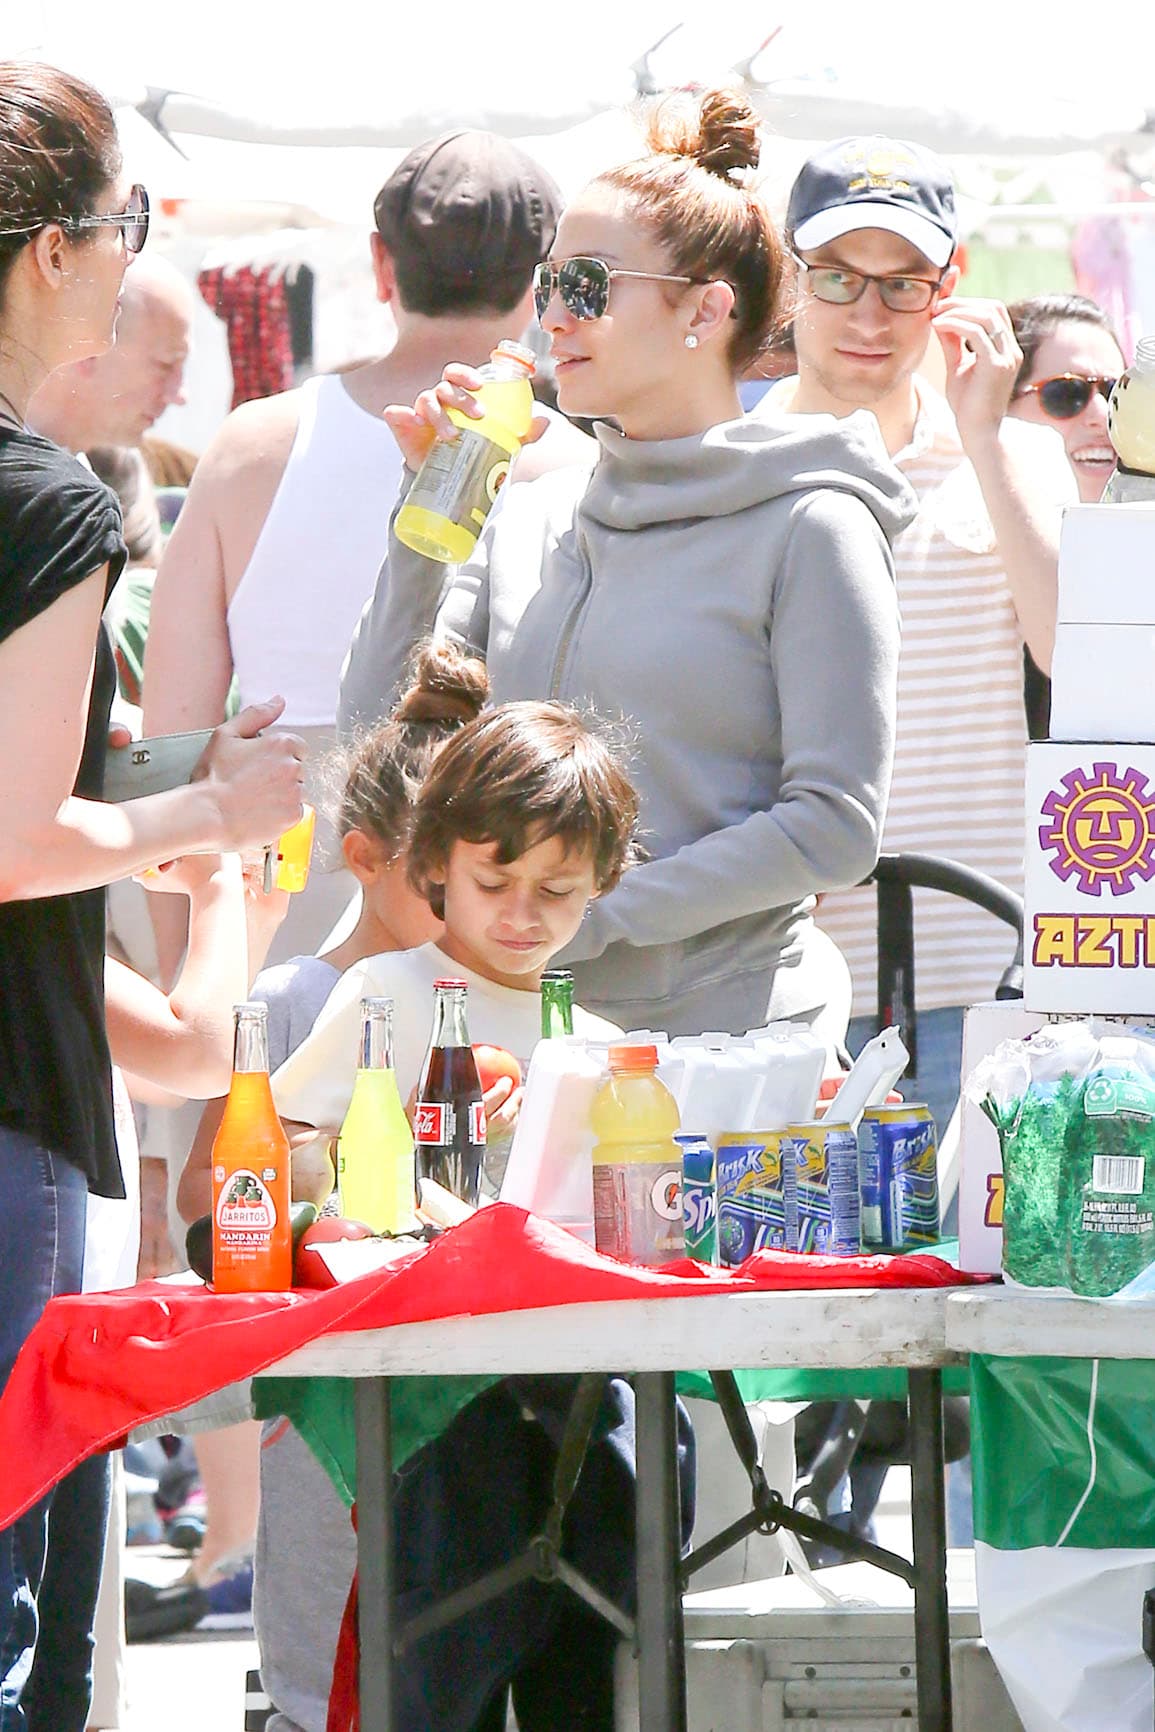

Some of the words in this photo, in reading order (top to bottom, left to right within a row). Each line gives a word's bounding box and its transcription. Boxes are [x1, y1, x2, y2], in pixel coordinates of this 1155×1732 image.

[1032, 913, 1155, 968] AZT
[222, 1211, 266, 1222] JARRITOS
[219, 1233, 271, 1241] MANDARIN
